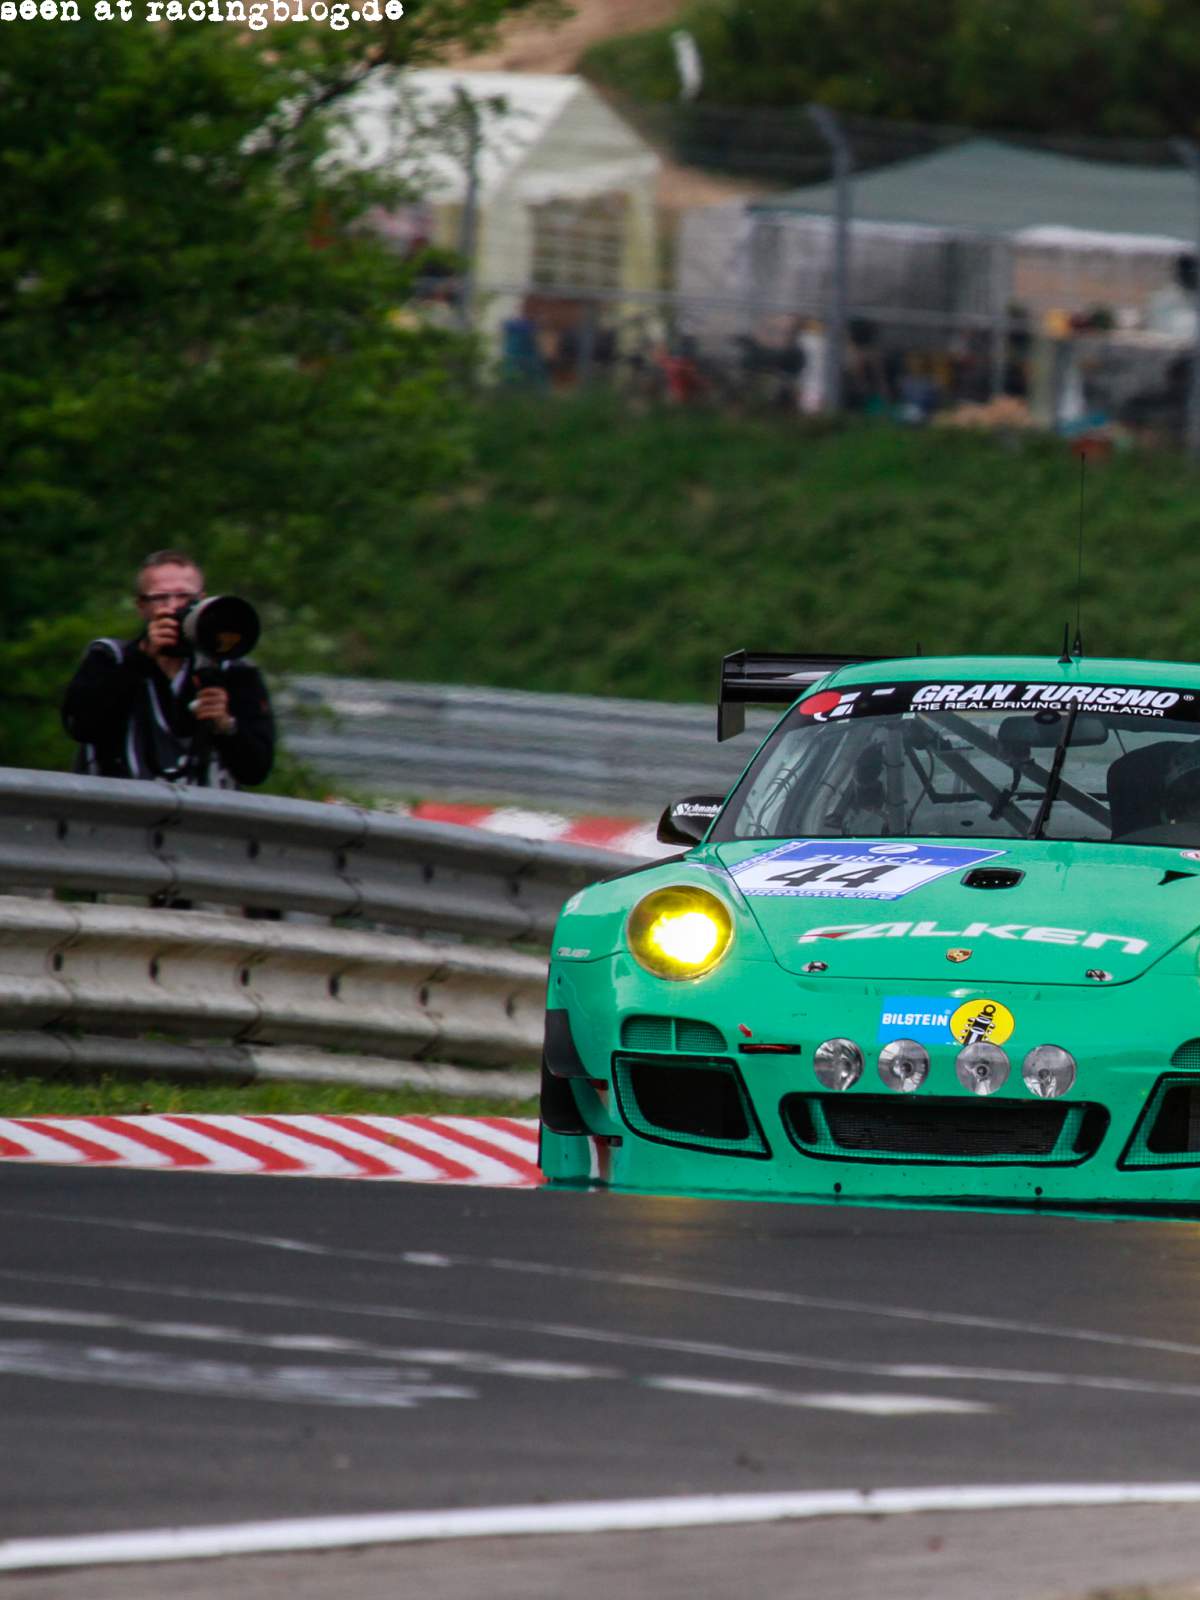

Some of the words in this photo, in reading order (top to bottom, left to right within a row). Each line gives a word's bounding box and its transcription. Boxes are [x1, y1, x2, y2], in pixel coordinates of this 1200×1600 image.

[909, 703, 941, 711] THE
[944, 702, 988, 710] REAL
[992, 701, 1061, 710] DRIVING
[911, 684, 1016, 703] GRAN
[1021, 684, 1180, 709] TURISMO
[803, 854, 932, 865] ZURICH
[766, 863, 900, 888] 44
[797, 921, 1149, 955] FALKEN
[882, 1013, 949, 1027] BILSTEIN
